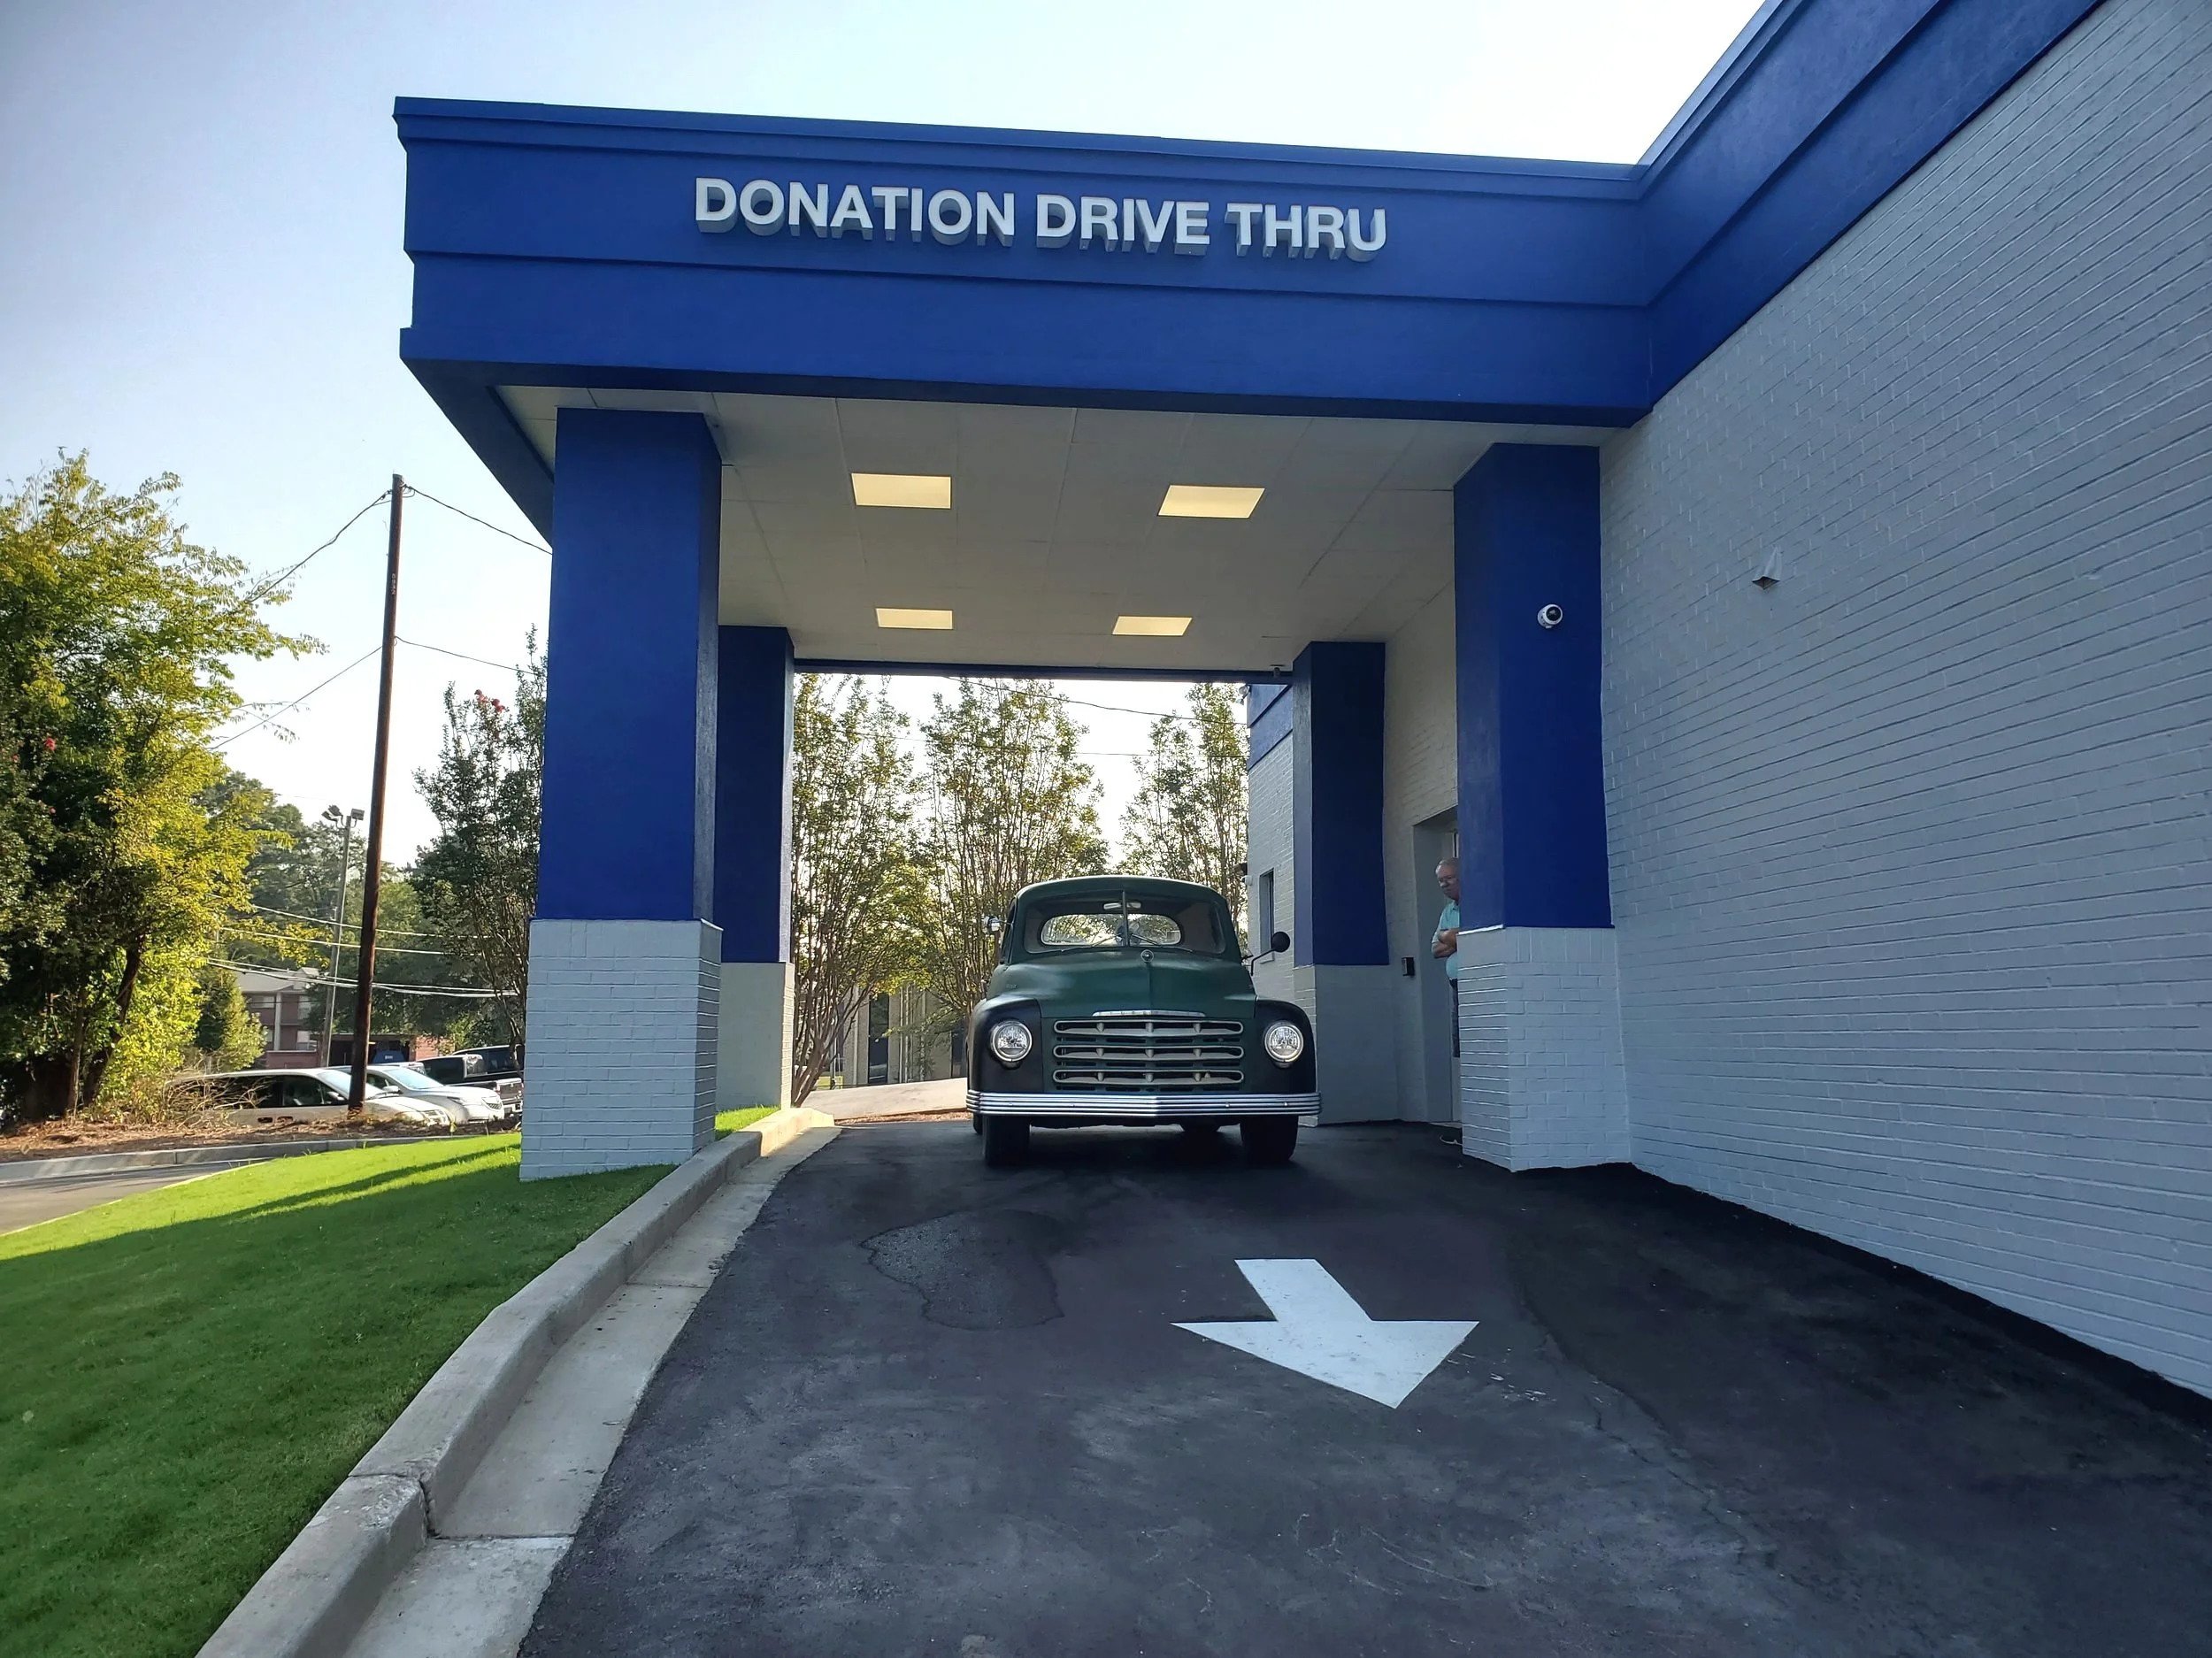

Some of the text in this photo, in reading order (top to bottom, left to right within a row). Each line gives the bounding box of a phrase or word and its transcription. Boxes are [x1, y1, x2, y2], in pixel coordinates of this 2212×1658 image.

[695, 177, 1386, 252] DONATION DRIVE THRU
